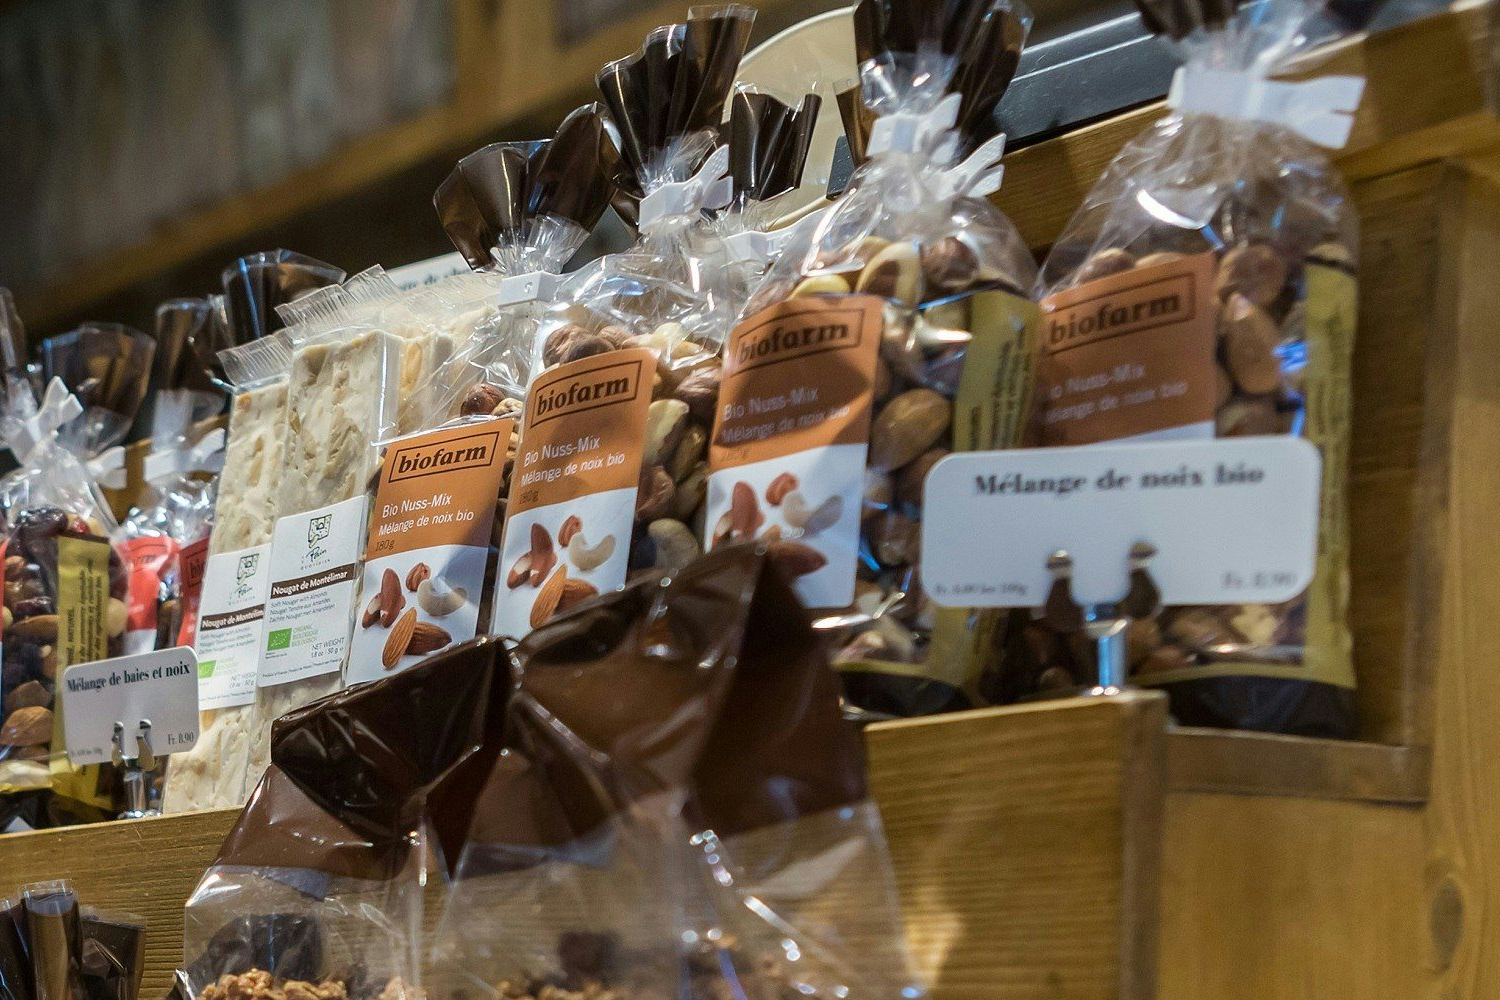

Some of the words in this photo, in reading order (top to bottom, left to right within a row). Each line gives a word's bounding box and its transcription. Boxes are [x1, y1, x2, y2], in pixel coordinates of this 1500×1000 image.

[1050, 294, 1181, 344] biofarm
[738, 323, 849, 363] biofarm
[537, 376, 629, 416] biofarm
[398, 445, 487, 474] biofarm
[523, 451, 539, 468] Bio
[542, 435, 600, 460] Nuss-Mix
[520, 468, 562, 488] Mélange
[564, 462, 578, 476] de
[580, 456, 603, 473] noix
[607, 451, 626, 467] bio
[974, 472, 1088, 498] Mélange
[1095, 468, 1129, 491] de
[1140, 464, 1202, 488] noix
[1214, 462, 1265, 486] bio
[382, 503, 398, 519] Bio
[400, 493, 453, 513] Nuss-Mix
[378, 520, 414, 537] Mélange
[416, 515, 430, 527] de
[432, 511, 453, 525] noix
[456, 509, 475, 522] bio
[272, 584, 300, 596] Nougat
[300, 580, 310, 591] de
[309, 571, 348, 588] Montélimar
[202, 617, 227, 629] Nougat
[227, 614, 236, 625] de
[235, 608, 265, 623] Montélim
[312, 643, 323, 651] NET
[323, 637, 345, 648] WEIGHT
[67, 677, 107, 693] Mélange
[109, 672, 122, 686] de
[124, 668, 150, 684] baies
[152, 664, 162, 679] et
[165, 660, 191, 677] noix
[167, 734, 176, 745] Fr.
[178, 731, 195, 745] 8.90
